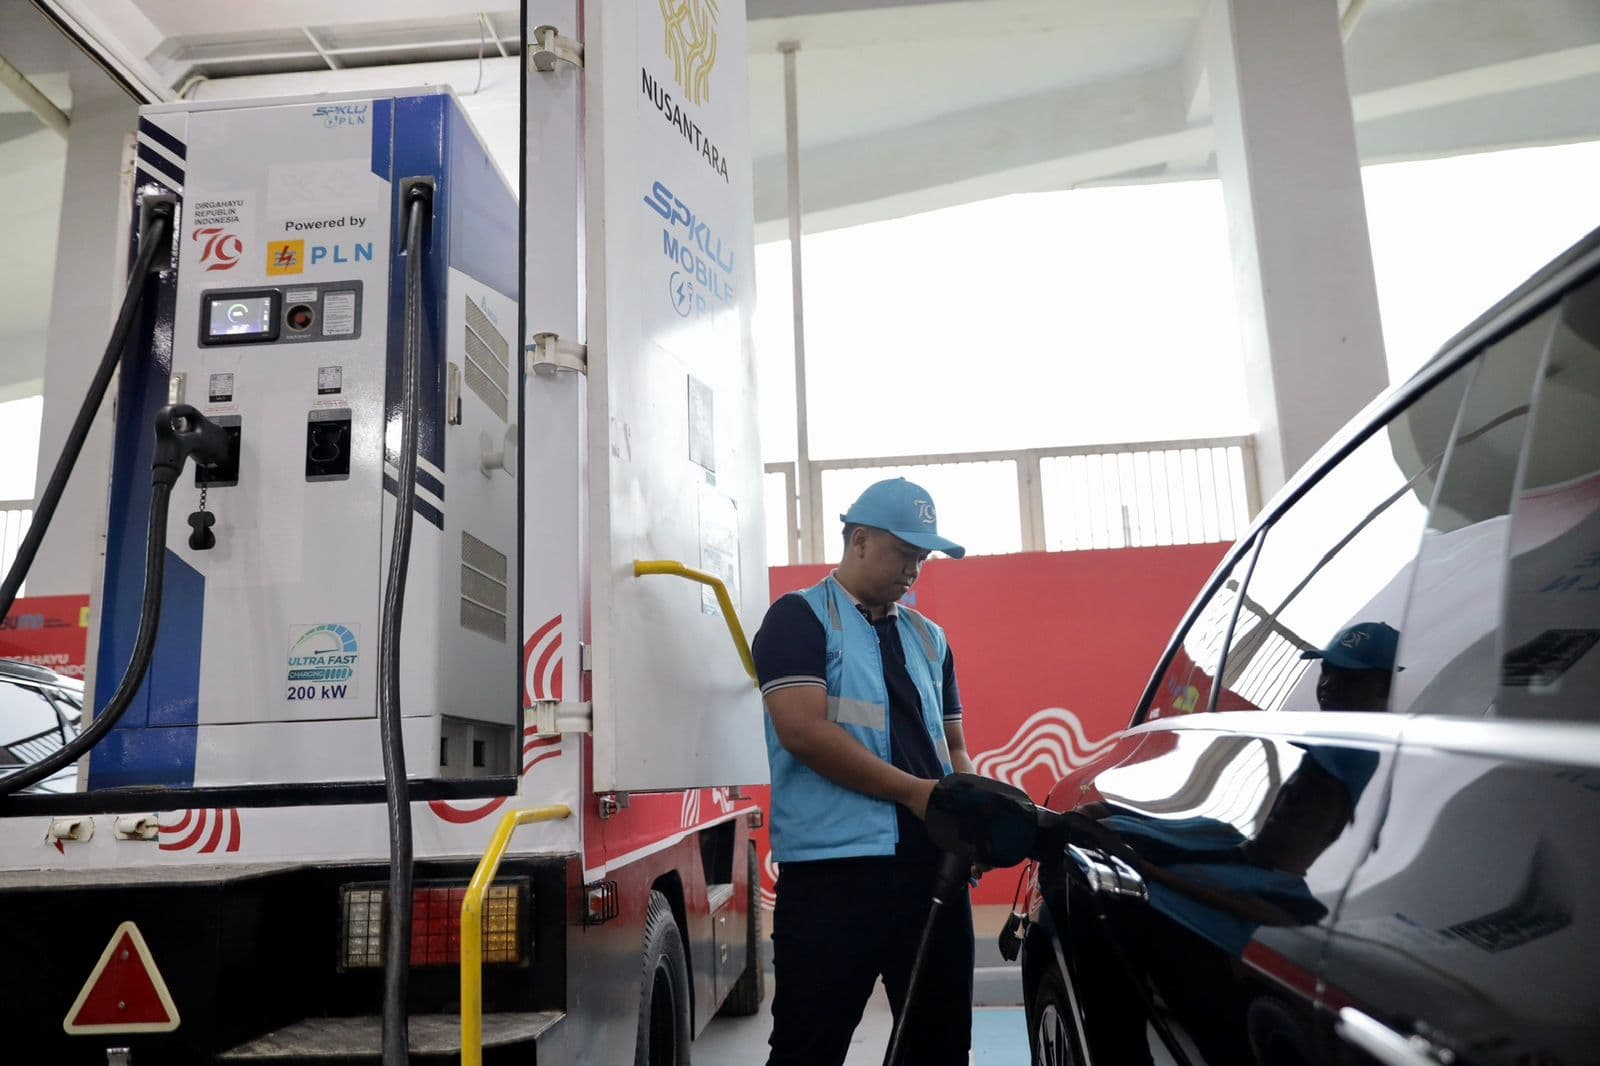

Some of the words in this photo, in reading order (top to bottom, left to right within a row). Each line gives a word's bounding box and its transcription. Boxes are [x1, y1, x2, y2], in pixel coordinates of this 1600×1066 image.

[339, 115, 365, 125] PLN
[642, 67, 729, 183] NUSANTARA
[195, 200, 243, 209] DIRGAHAYU
[195, 209, 237, 217] REPUBLIK
[195, 216, 240, 225] INDONESIA
[285, 217, 345, 231] Powered
[350, 216, 366, 227] by
[643, 180, 734, 274] SPKLU
[310, 243, 372, 265] PLN
[288, 656, 325, 666] ULTRA
[327, 655, 357, 665] FAST
[287, 686, 315, 700] 200
[321, 684, 347, 699] kW
